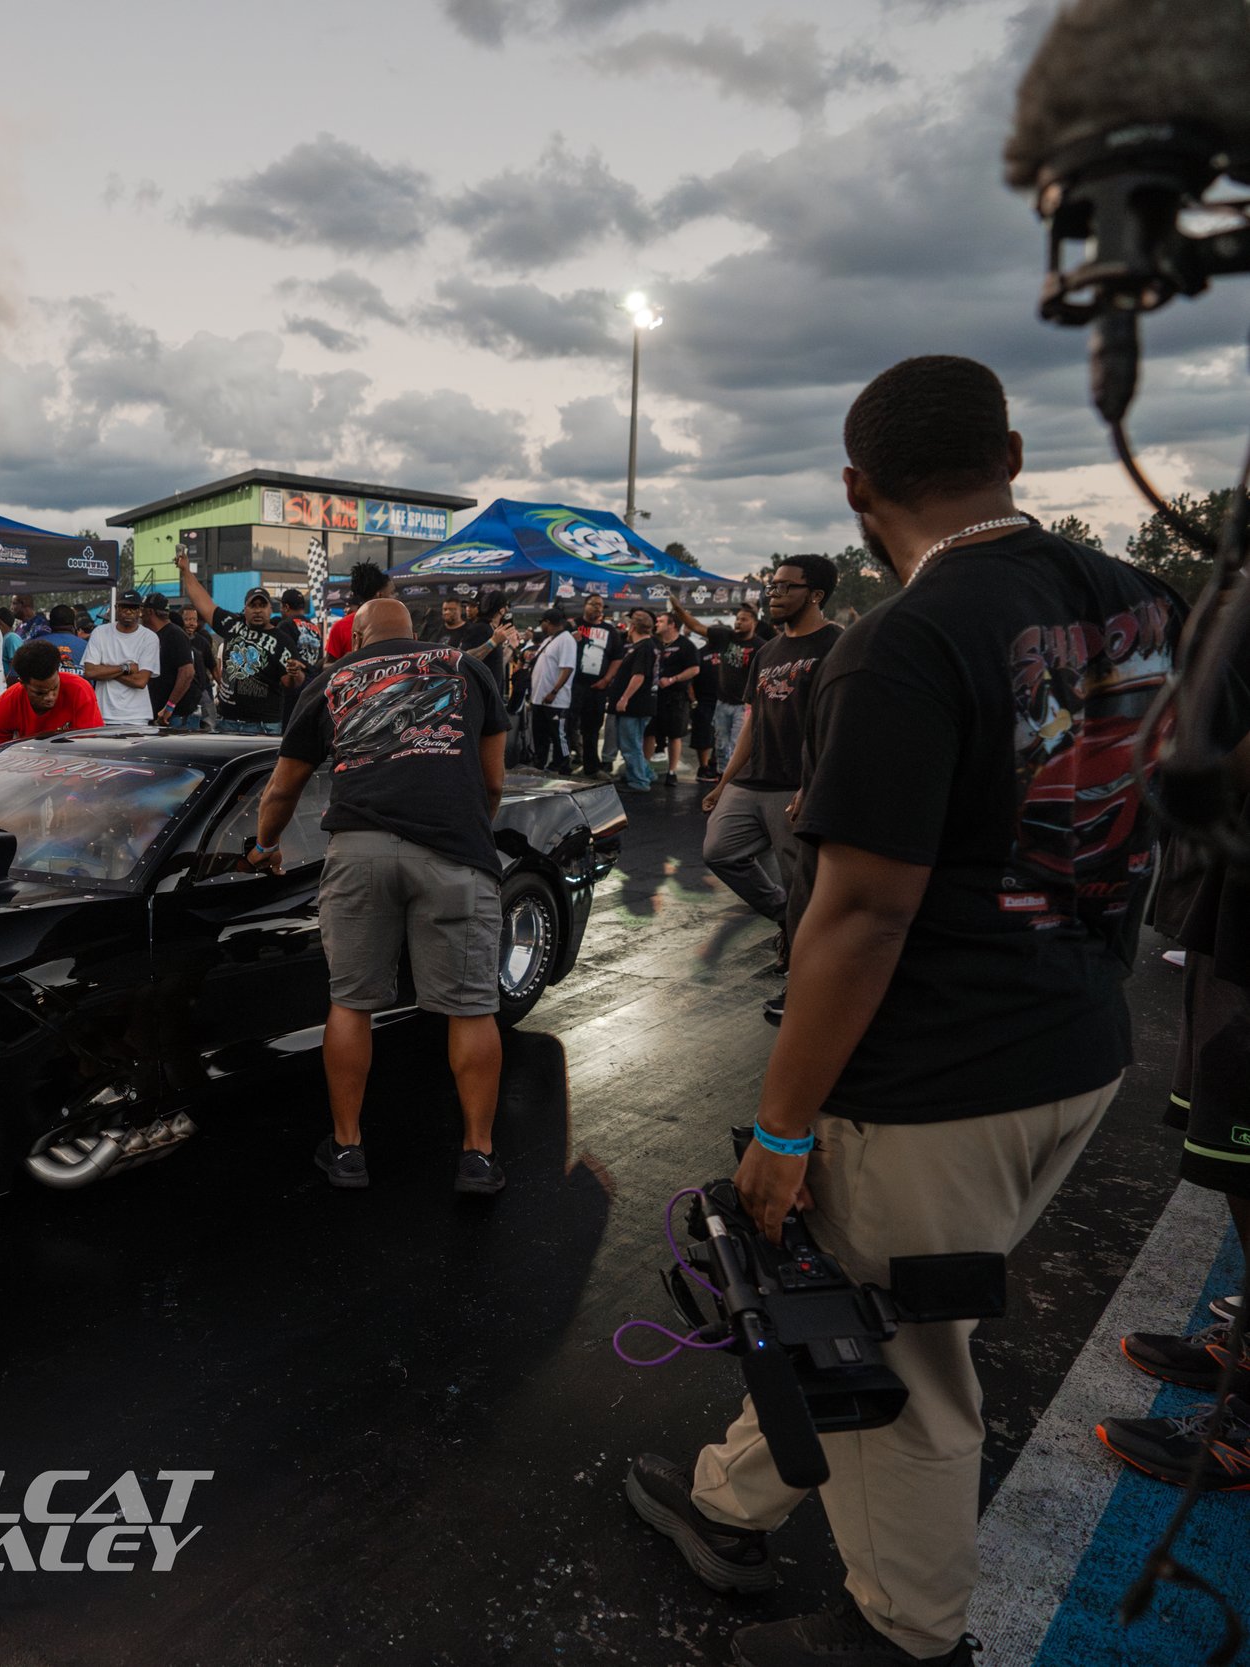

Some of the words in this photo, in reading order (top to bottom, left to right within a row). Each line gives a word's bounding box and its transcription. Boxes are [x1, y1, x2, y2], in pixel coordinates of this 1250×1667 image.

[332, 514, 359, 529] MAG
[391, 509, 406, 526] LEE
[407, 511, 446, 530] SPARKS
[333, 660, 412, 714] BLOOD
[413, 737, 451, 750] Racing
